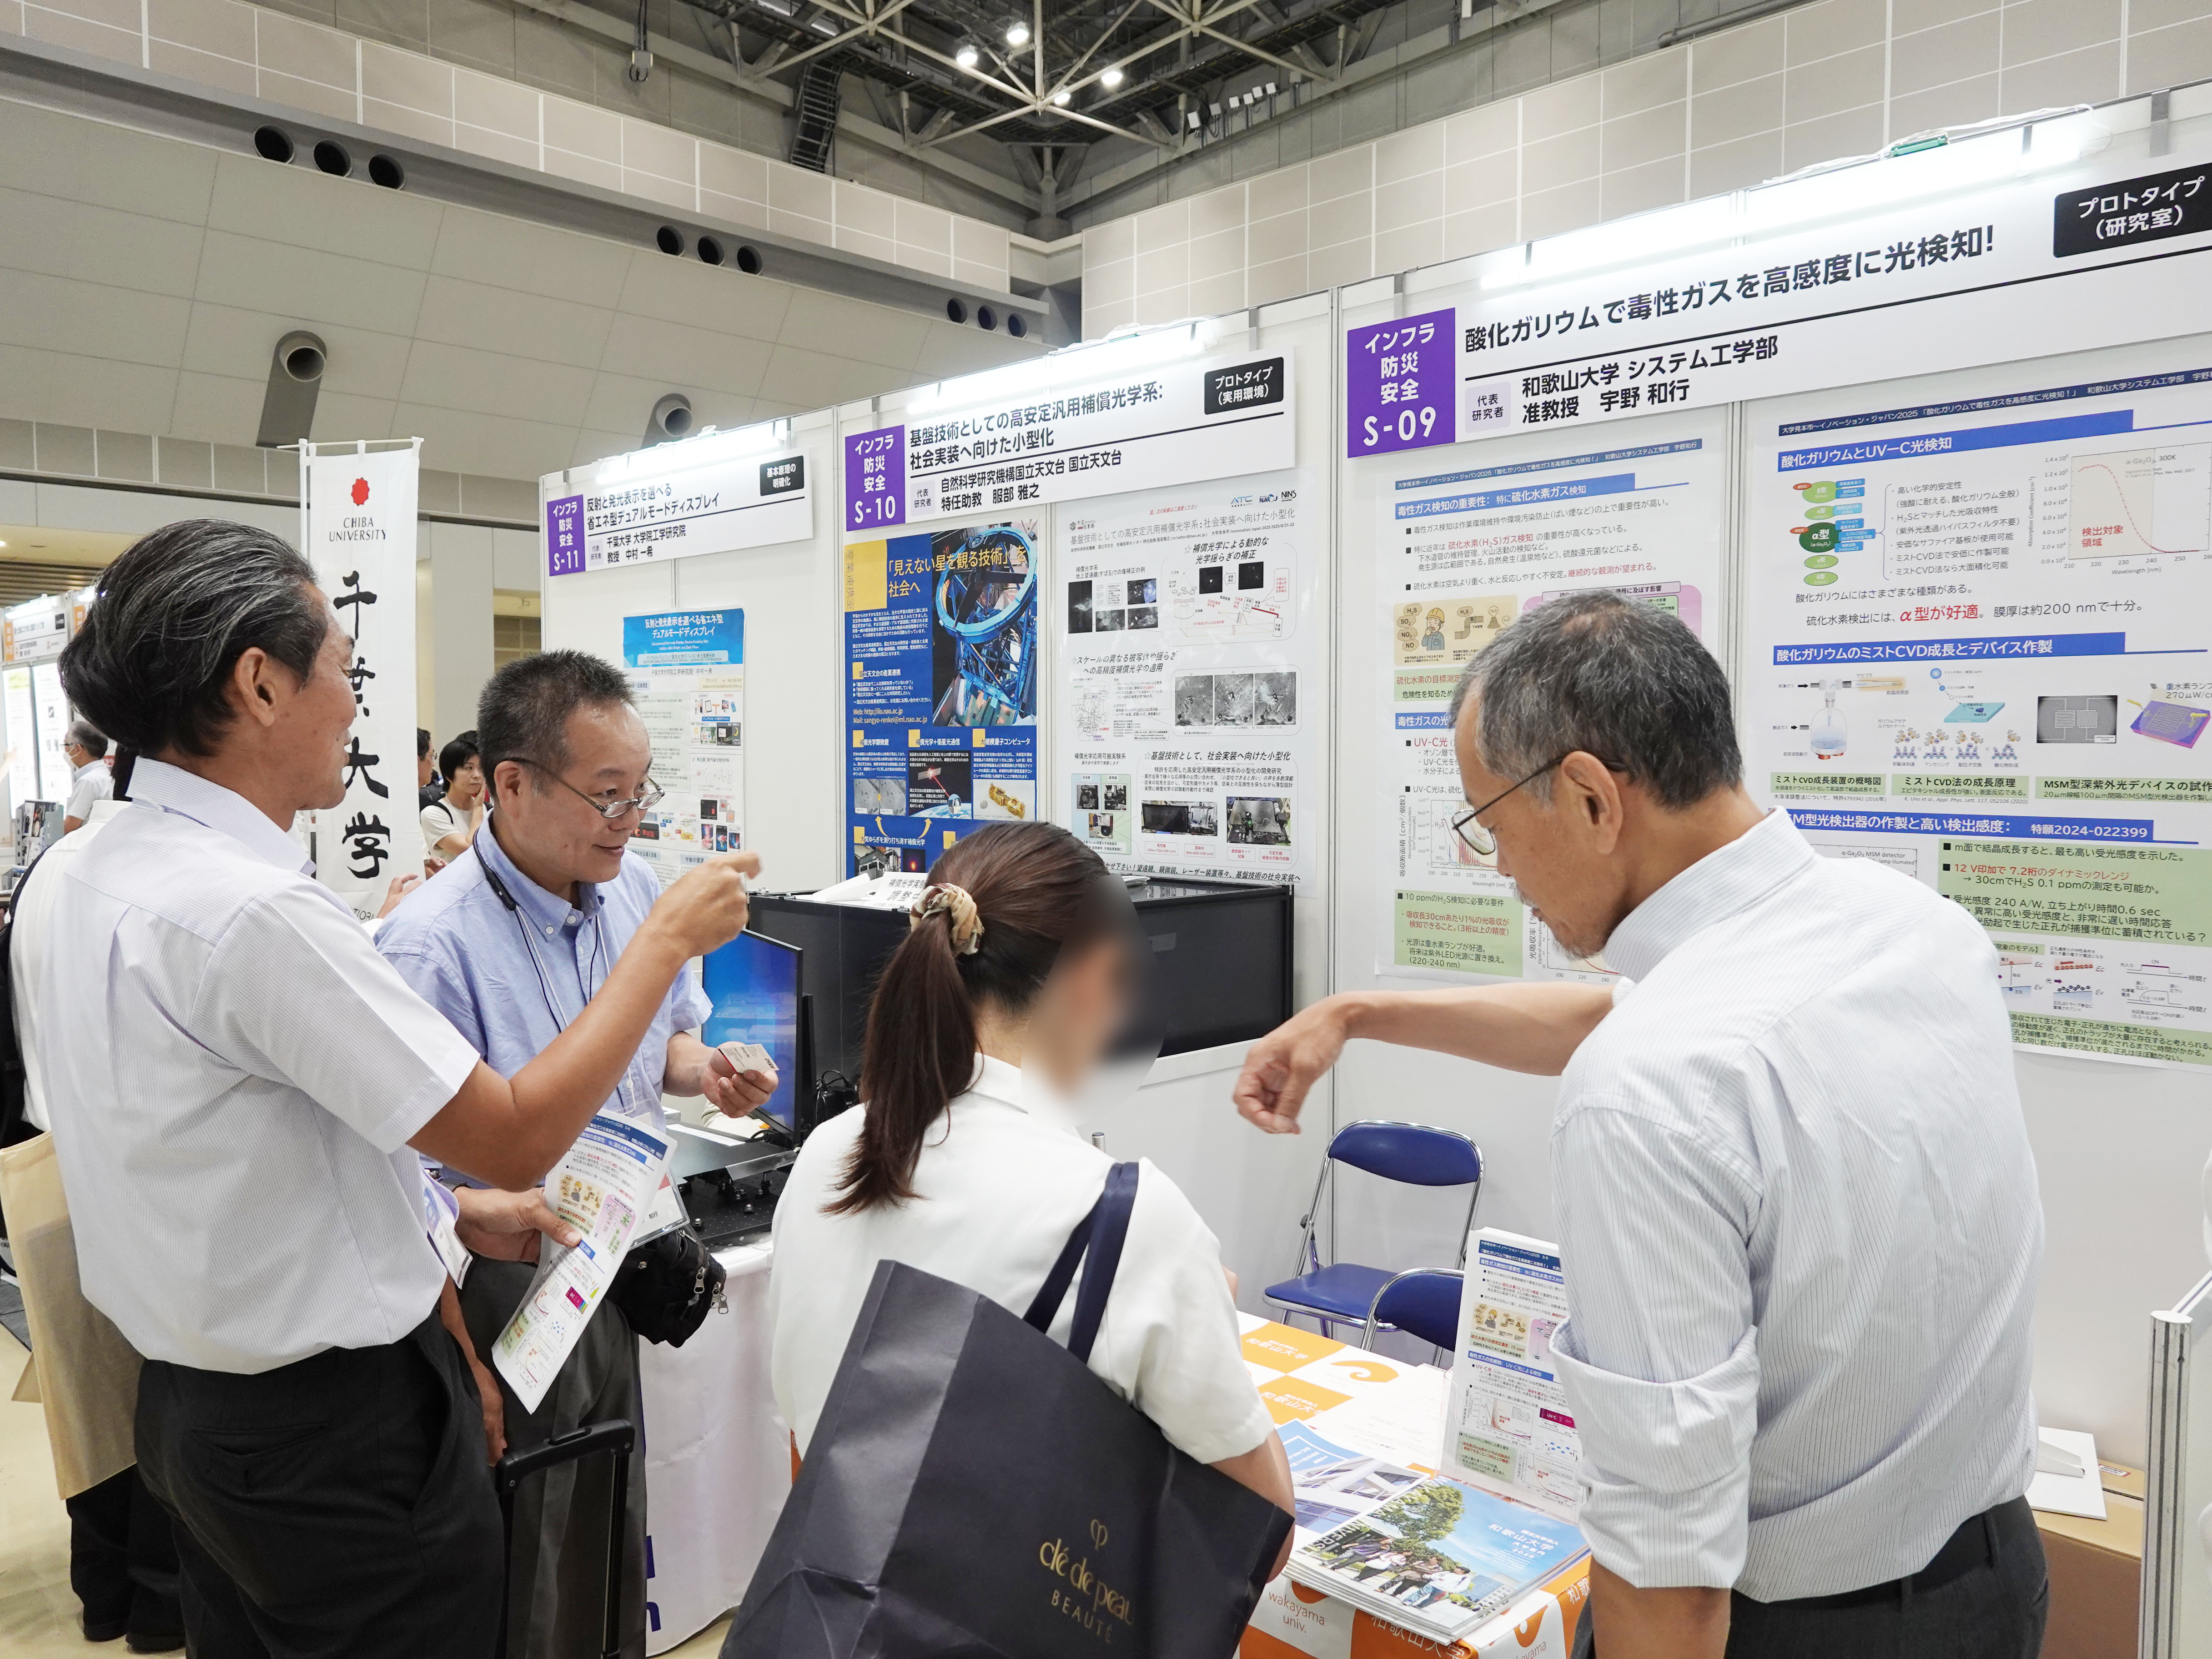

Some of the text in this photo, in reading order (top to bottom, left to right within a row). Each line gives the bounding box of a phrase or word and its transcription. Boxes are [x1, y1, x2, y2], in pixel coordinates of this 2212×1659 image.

[2077, 175, 2205, 218] プロトタイプ
[2096, 205, 2184, 239] (研究室)
[1465, 225, 1993, 352] 酸化ガリウムで毒性ガスを高感度に光検知!
[1365, 323, 1436, 355] インフラ
[1381, 352, 1419, 379] 防災
[1523, 335, 1778, 398] 和歌山大学 システム工学部
[1215, 366, 1273, 389] プロトタイプ
[2087, 375, 2184, 395] 和歌山大学システム工学部
[1218, 382, 1269, 406] (実用環境)
[1381, 378, 1419, 404] 安全
[1478, 393, 1499, 407] 代表
[1523, 379, 1689, 424] 准教授 宇野 和行
[910, 381, 1163, 448] 基盤技術としての高安定汎用補償光学系:
[1472, 406, 1504, 421] 研究者
[1364, 406, 1436, 447] S-09
[855, 433, 893, 455] インフラ
[910, 427, 1054, 471] 社会実装へ向けた小型化
[1674, 442, 1697, 451] 宇野和行
[767, 463, 796, 478] 基本原理の
[864, 456, 885, 473] 防災
[941, 450, 1121, 493] 自然科学研究機構国立天文台 国立天文台
[773, 476, 791, 488] 明確化
[864, 474, 885, 492] 安全
[1898, 481, 1962, 495] 高い化学的安定性
[587, 483, 672, 513] 反射と発光表示を選べる
[917, 488, 929, 498] 代表
[941, 483, 1040, 512] 特任助教 服部 雅之
[1231, 495, 1253, 504] ATC
[1282, 490, 1296, 498] NINS
[1398, 485, 1586, 517] 毒性ガス検知の重要性： 特に硫化水素ガス検知
[553, 504, 578, 518] インフラ
[587, 492, 720, 531] 省エネ型デュアルモードディスプレイ
[854, 495, 895, 523] S-10
[914, 498, 932, 508] 研究者
[343, 517, 373, 528] CHIBA
[558, 518, 573, 532] 防災
[2081, 525, 2123, 537] 検出対象
[329, 529, 387, 541] UNIVERSITY
[558, 533, 573, 547] 安全
[607, 524, 686, 548] 千葉大学 大学院工学研究院
[1414, 525, 1627, 553] 特に近年は の重要性が高くなっている。
[1812, 529, 1830, 540] α型
[1896, 532, 2014, 549] 安価なサファイア基板が使用可能
[2081, 538, 2102, 547] 領域
[1193, 537, 1269, 553] 補償光学による動的な
[1418, 543, 1548, 562] 下水道管の維持管理、火山活動の検知など。
[554, 550, 578, 571] S-11
[607, 545, 653, 564] 教授 中村 一希
[1195, 549, 1257, 564] 光学揺らぎの補正
[1896, 547, 2009, 562] ミストCVD法で安価に作製可能
[1895, 561, 2009, 576] ミストCVD法なら大面積化可能
[889, 580, 920, 598] 社会へ
[1795, 584, 1973, 603] 酸化ガリウムにはさまざまな種類がある。
[1994, 603, 2071, 618] 膜厚は約200
[2076, 599, 2143, 613] nmで十分。
[645, 614, 724, 629] 反射と発光表示を選べる省エネ型
[652, 627, 715, 638] デュアルモードディスプレイ
[1076, 650, 1177, 664] スケールの異なる被写体や揺らぎ
[1777, 639, 2053, 662] 酸化ガリウムのミストCVD成長とデバイス作製
[1083, 663, 1163, 674] への高精度補償光学の適用
[1414, 737, 1448, 748] UV-C光
[1151, 751, 1291, 761] 基盤技術として、社会実装へ向けた小型化
[1775, 776, 1881, 786] ミストCVD成長装置の概略図
[1905, 776, 2016, 788] ミストCVD法の成長原理
[2031, 824, 2147, 838] 特願2024-022399
[1955, 843, 2185, 862] m面で結晶成長すると、最も高い受光感度を示した。
[1955, 864, 2130, 881] 12 V印加で 7.2桁のダイナミックレンジ
[2038, 878, 2053, 887] 0.1
[2059, 880, 2162, 895] ppmの測定も可能か。
[1406, 893, 1414, 901] 10
[1995, 897, 2161, 917] 240 sec
[1406, 911, 1509, 926] 吸収長30cmあたり1%の光吸収が
[1975, 907, 2172, 928] 異常に高い受光感度と、非常に遅い時間応答
[1410, 921, 1509, 936] 検知できること。(3桁以上の精度)
[1406, 938, 1486, 953] 光源は重水素ランプが好適。
[1409, 946, 1504, 965] 将来は紫外LED光源に置き換え。
[1410, 956, 1460, 969] (220-240 nm)
[1246, 1337, 1309, 1360] 和歌山大学
[1488, 1523, 1554, 1551] 和歌山大学
[1512, 1548, 1535, 1559] 2026
[1039, 1538, 1069, 1577] clé
[1070, 1557, 1094, 1595] de
[1268, 1590, 1325, 1626] wakayama
[1283, 1614, 1307, 1634] univ.
